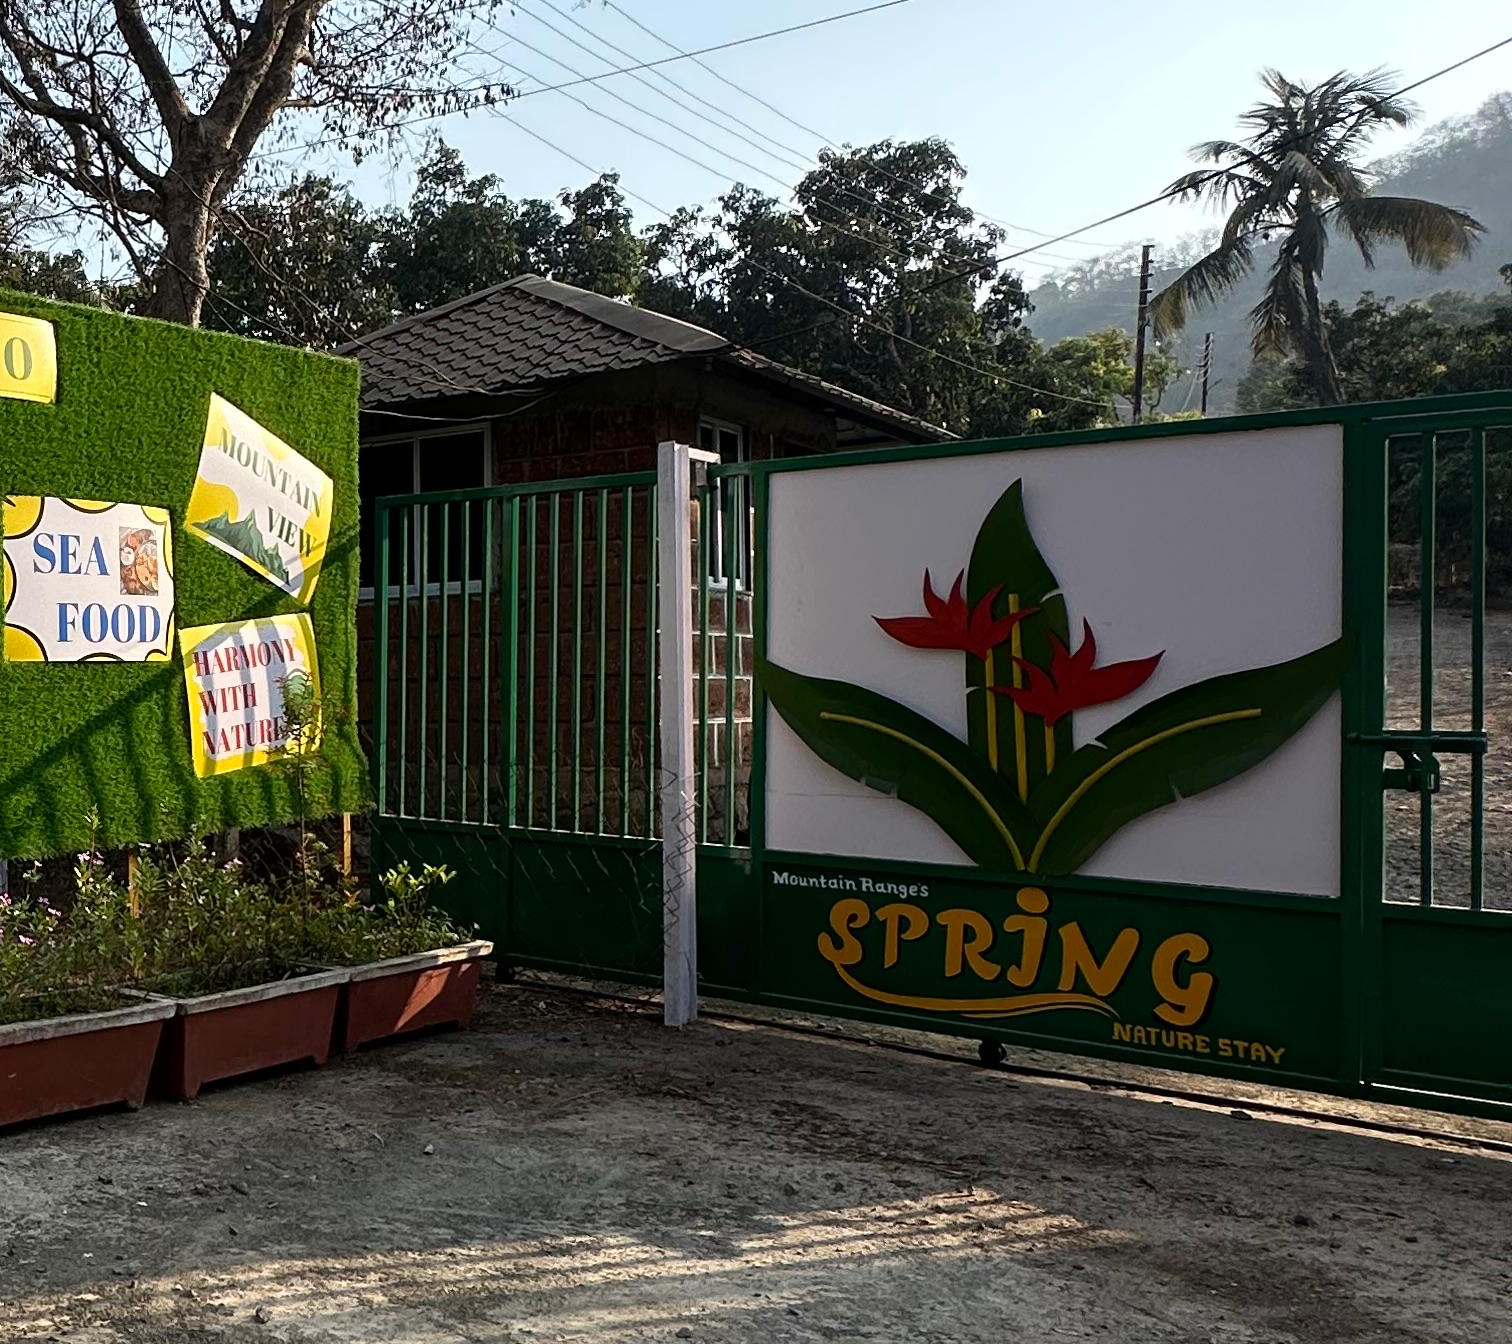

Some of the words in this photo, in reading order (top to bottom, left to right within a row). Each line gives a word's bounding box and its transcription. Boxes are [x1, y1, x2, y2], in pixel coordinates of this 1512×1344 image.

[217, 426, 322, 518] MOUNTAIN
[266, 506, 318, 558] VIEW
[32, 532, 111, 577] SEA
[56, 601, 162, 645] FOOD
[191, 636, 298, 678] HARMONY
[199, 681, 257, 718] WITH
[771, 870, 858, 891] Mountain
[1112, 1022, 1211, 1054] NATURE
[1217, 1038, 1286, 1065] STAY
